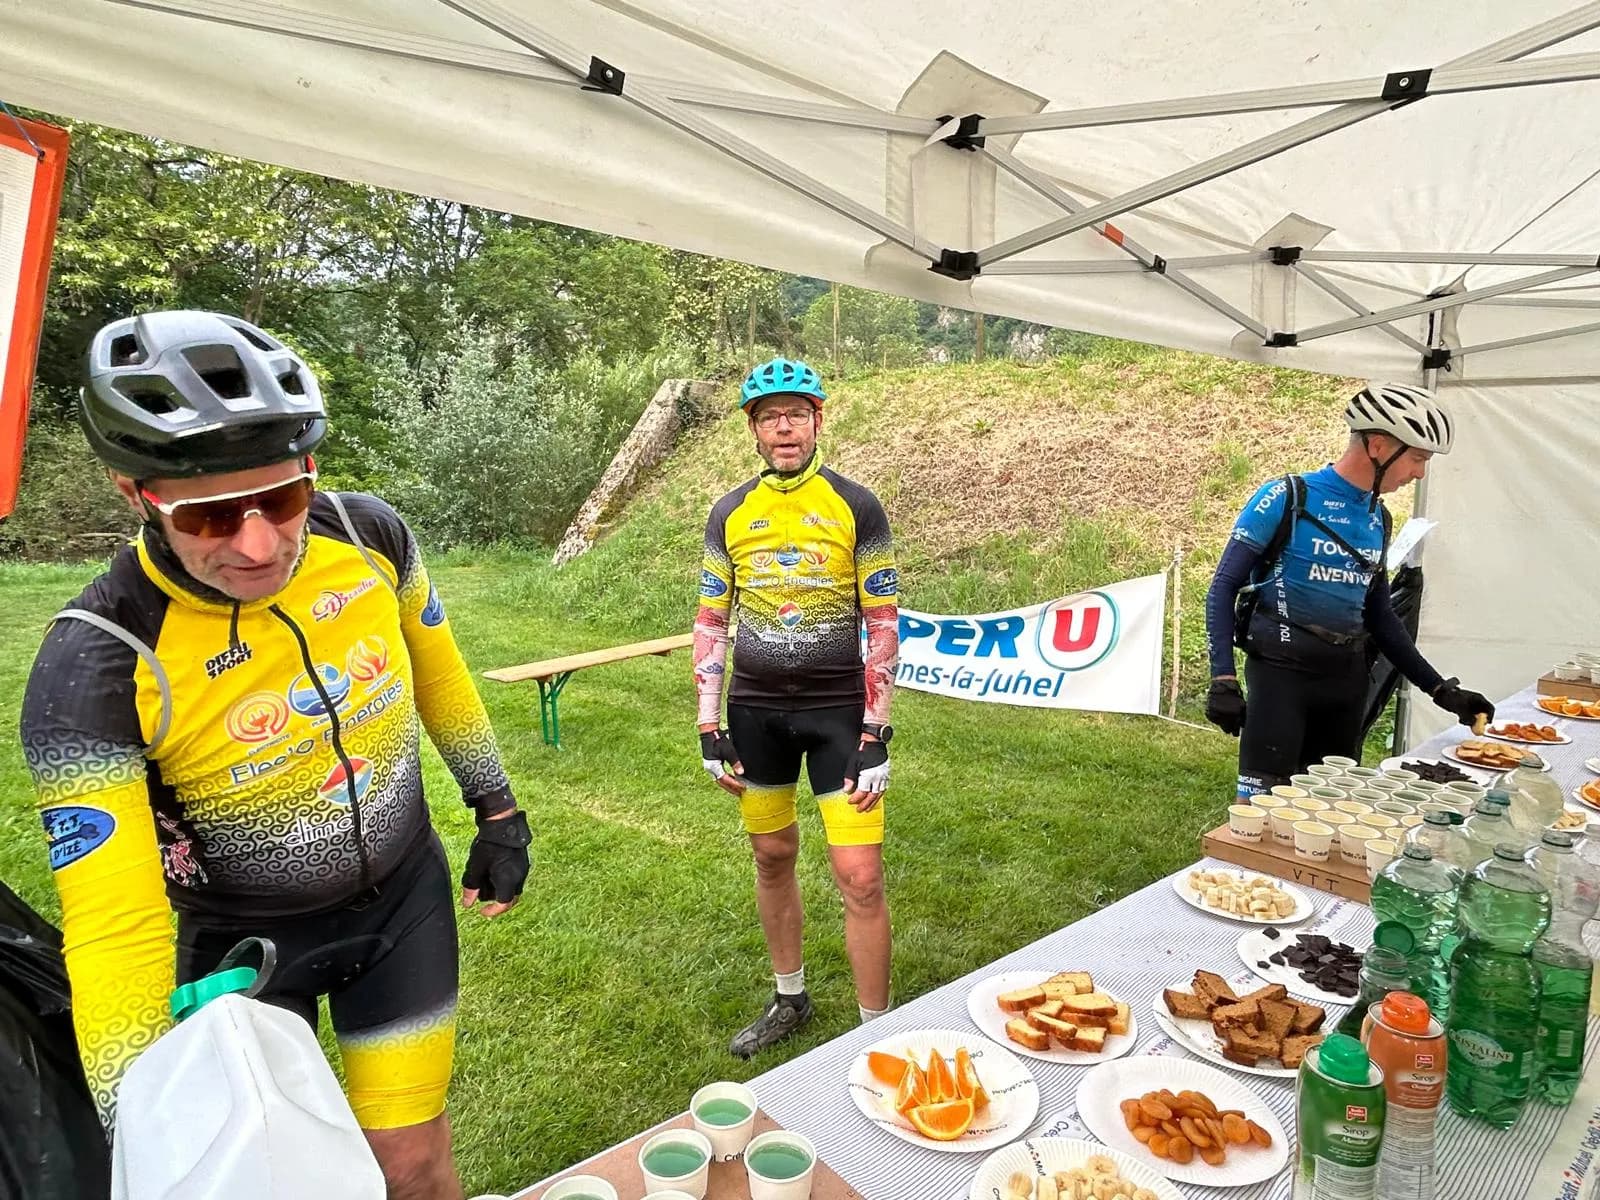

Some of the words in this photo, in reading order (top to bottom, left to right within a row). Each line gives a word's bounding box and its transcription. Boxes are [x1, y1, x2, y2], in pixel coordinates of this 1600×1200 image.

[898, 615, 1025, 658] PER
[1052, 607, 1101, 652] U
[205, 642, 248, 671] DIFFU
[207, 650, 252, 680] SPORT
[896, 656, 1065, 698] ines-la-Juhel
[1342, 1125, 1369, 1136] Sirop
